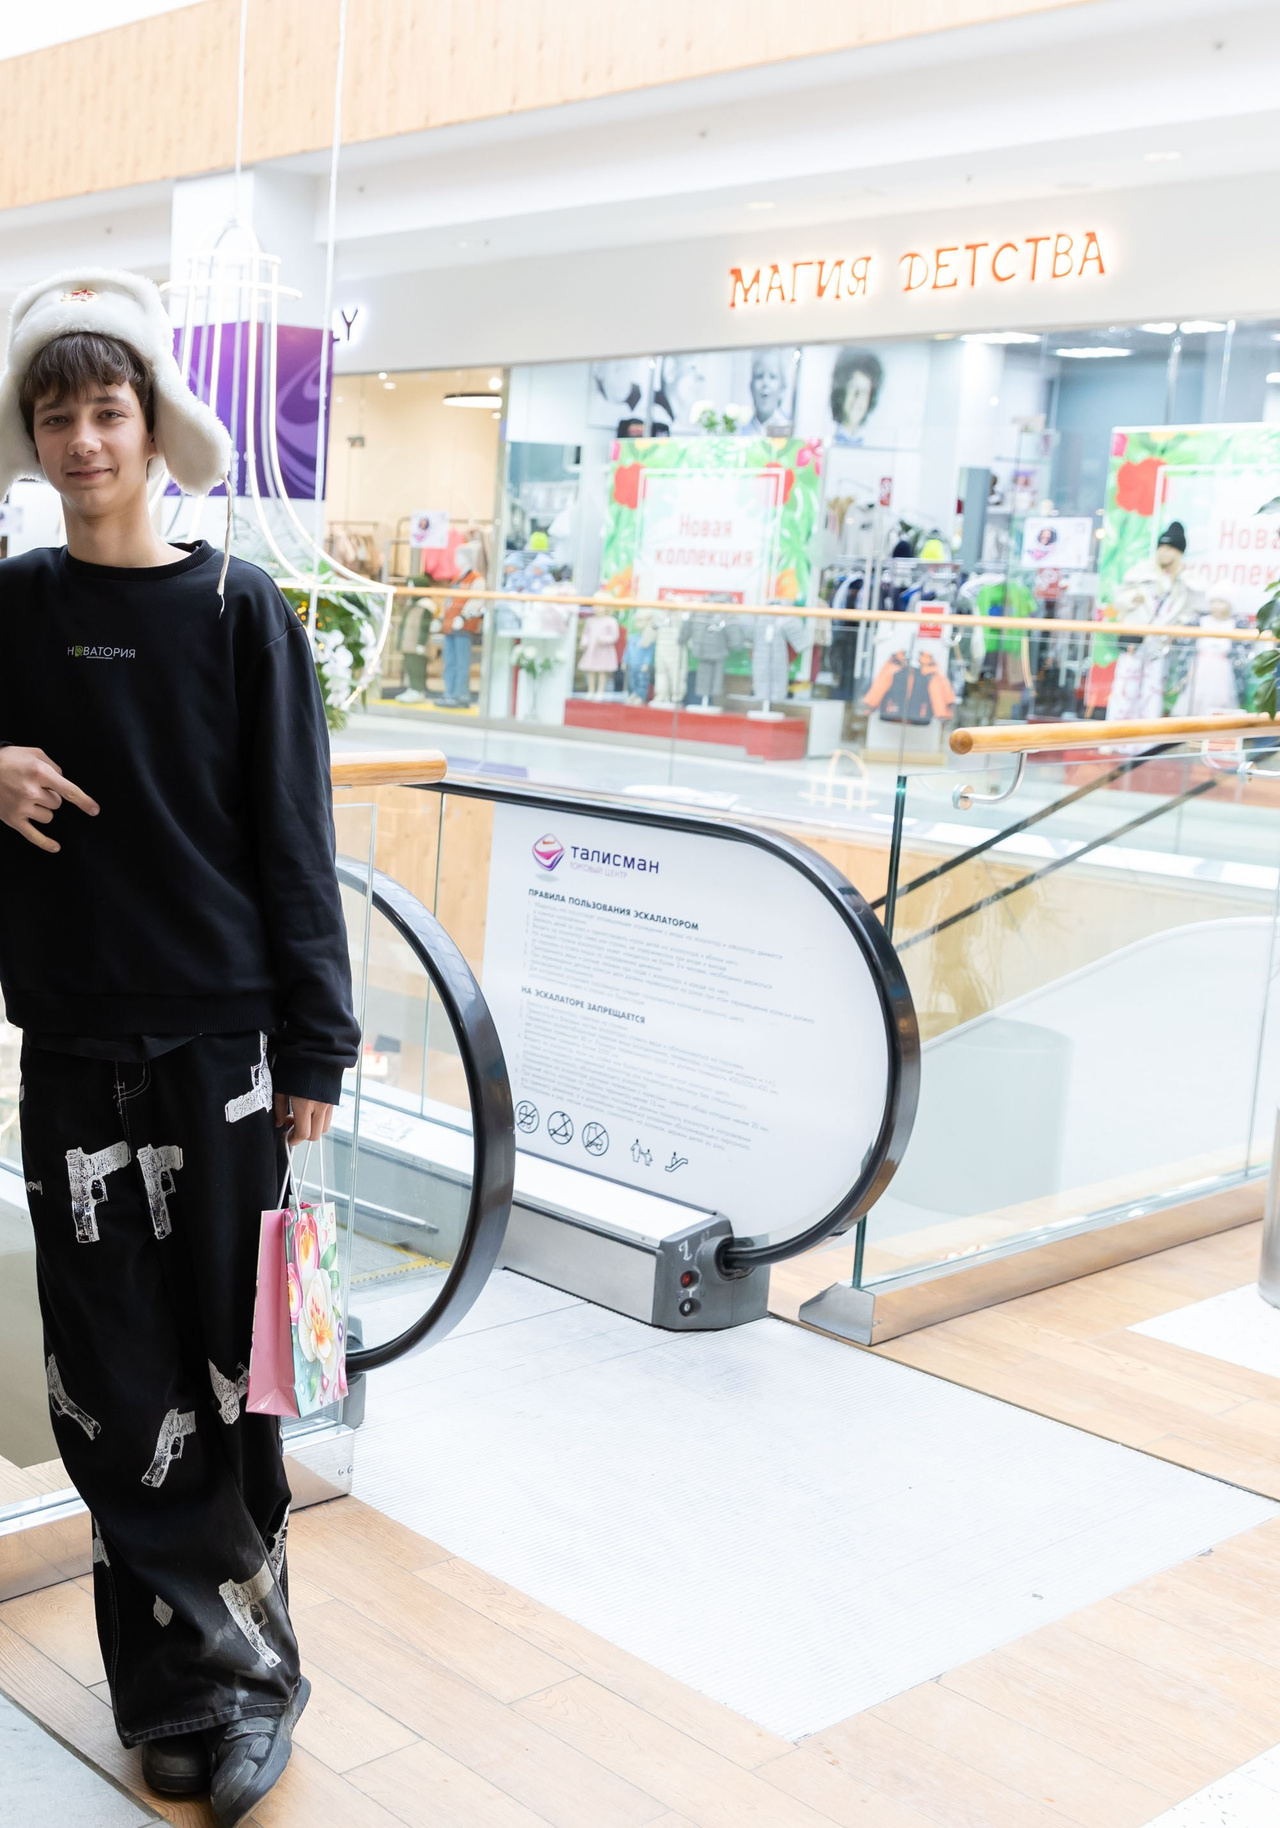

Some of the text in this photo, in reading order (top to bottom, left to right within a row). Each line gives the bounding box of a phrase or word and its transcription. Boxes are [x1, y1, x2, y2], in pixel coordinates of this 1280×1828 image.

[730, 232, 1106, 308] МАГИЯ ДЕТСТВА
[679, 513, 732, 538] Новая
[1219, 520, 1280, 550] Нова
[655, 548, 753, 569] коллекция
[528, 888, 699, 931] ПРАВИЛА ПОЛЬЗОВАНИЯ ЭСКАЛАТОРОМ
[521, 985, 646, 1024] НА ЭСКАЛАТОРЕ ЗАПРЕЩАЕТСЯ
